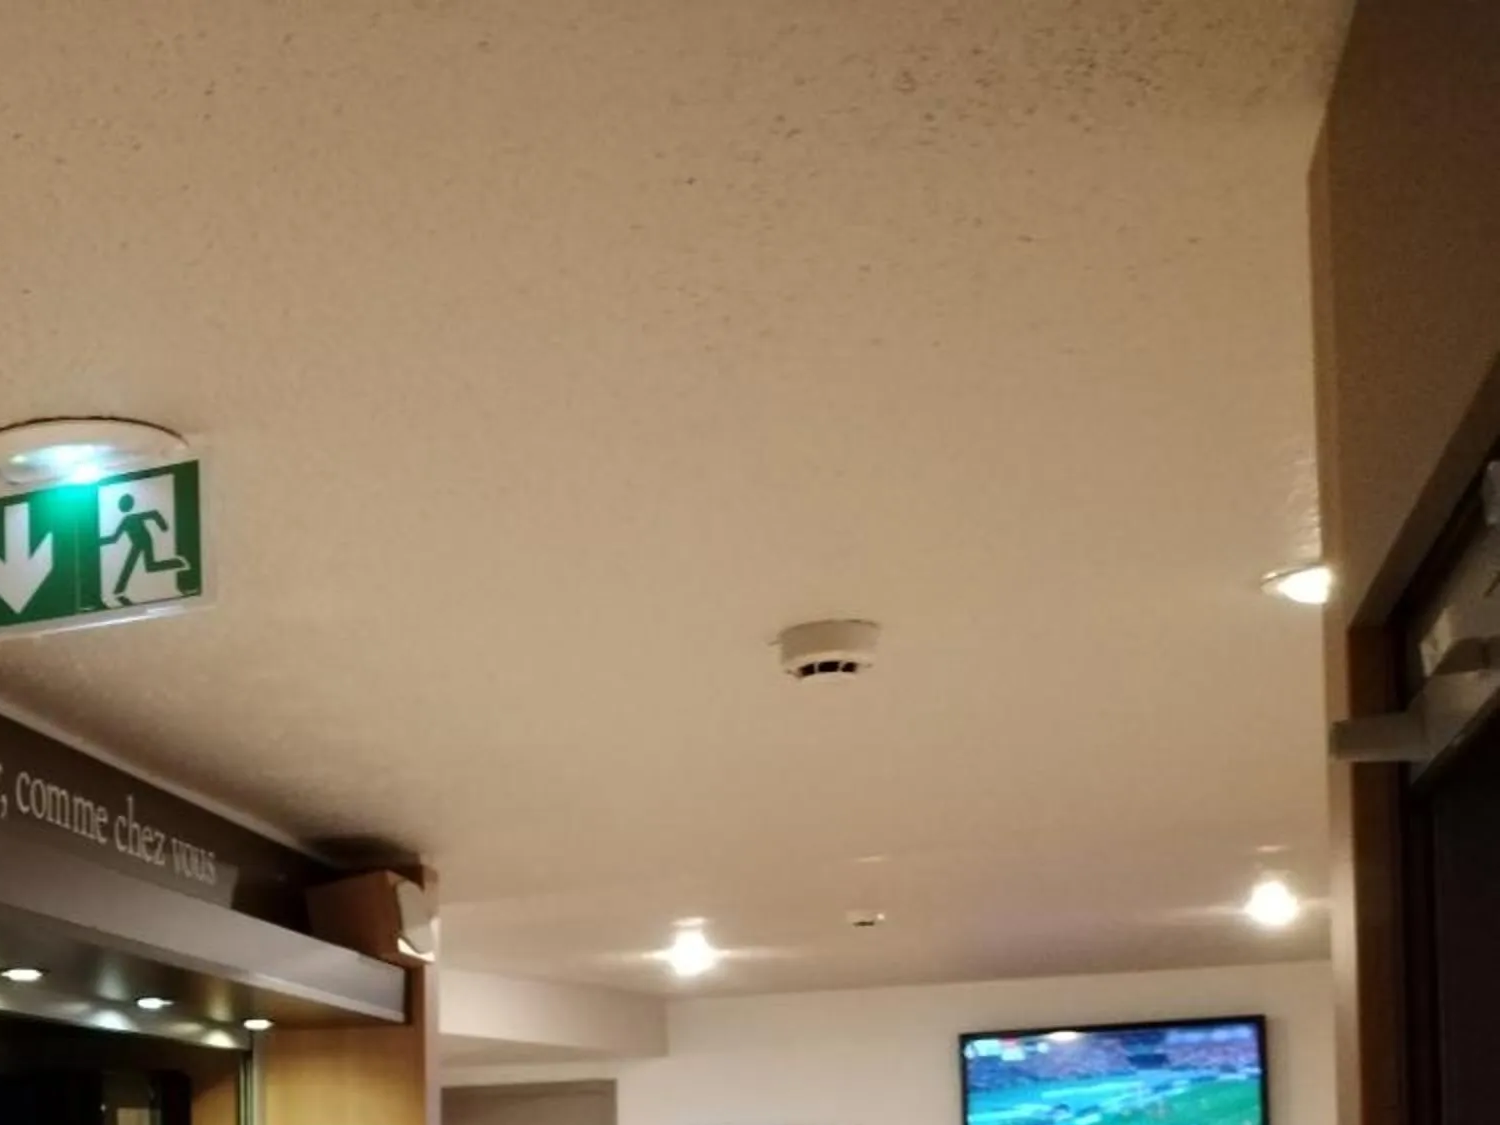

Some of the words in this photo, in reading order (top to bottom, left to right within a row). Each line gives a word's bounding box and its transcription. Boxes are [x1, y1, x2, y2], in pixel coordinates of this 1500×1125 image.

[16, 770, 108, 844] comme
[114, 796, 166, 866] chez
[171, 837, 217, 884] vous
